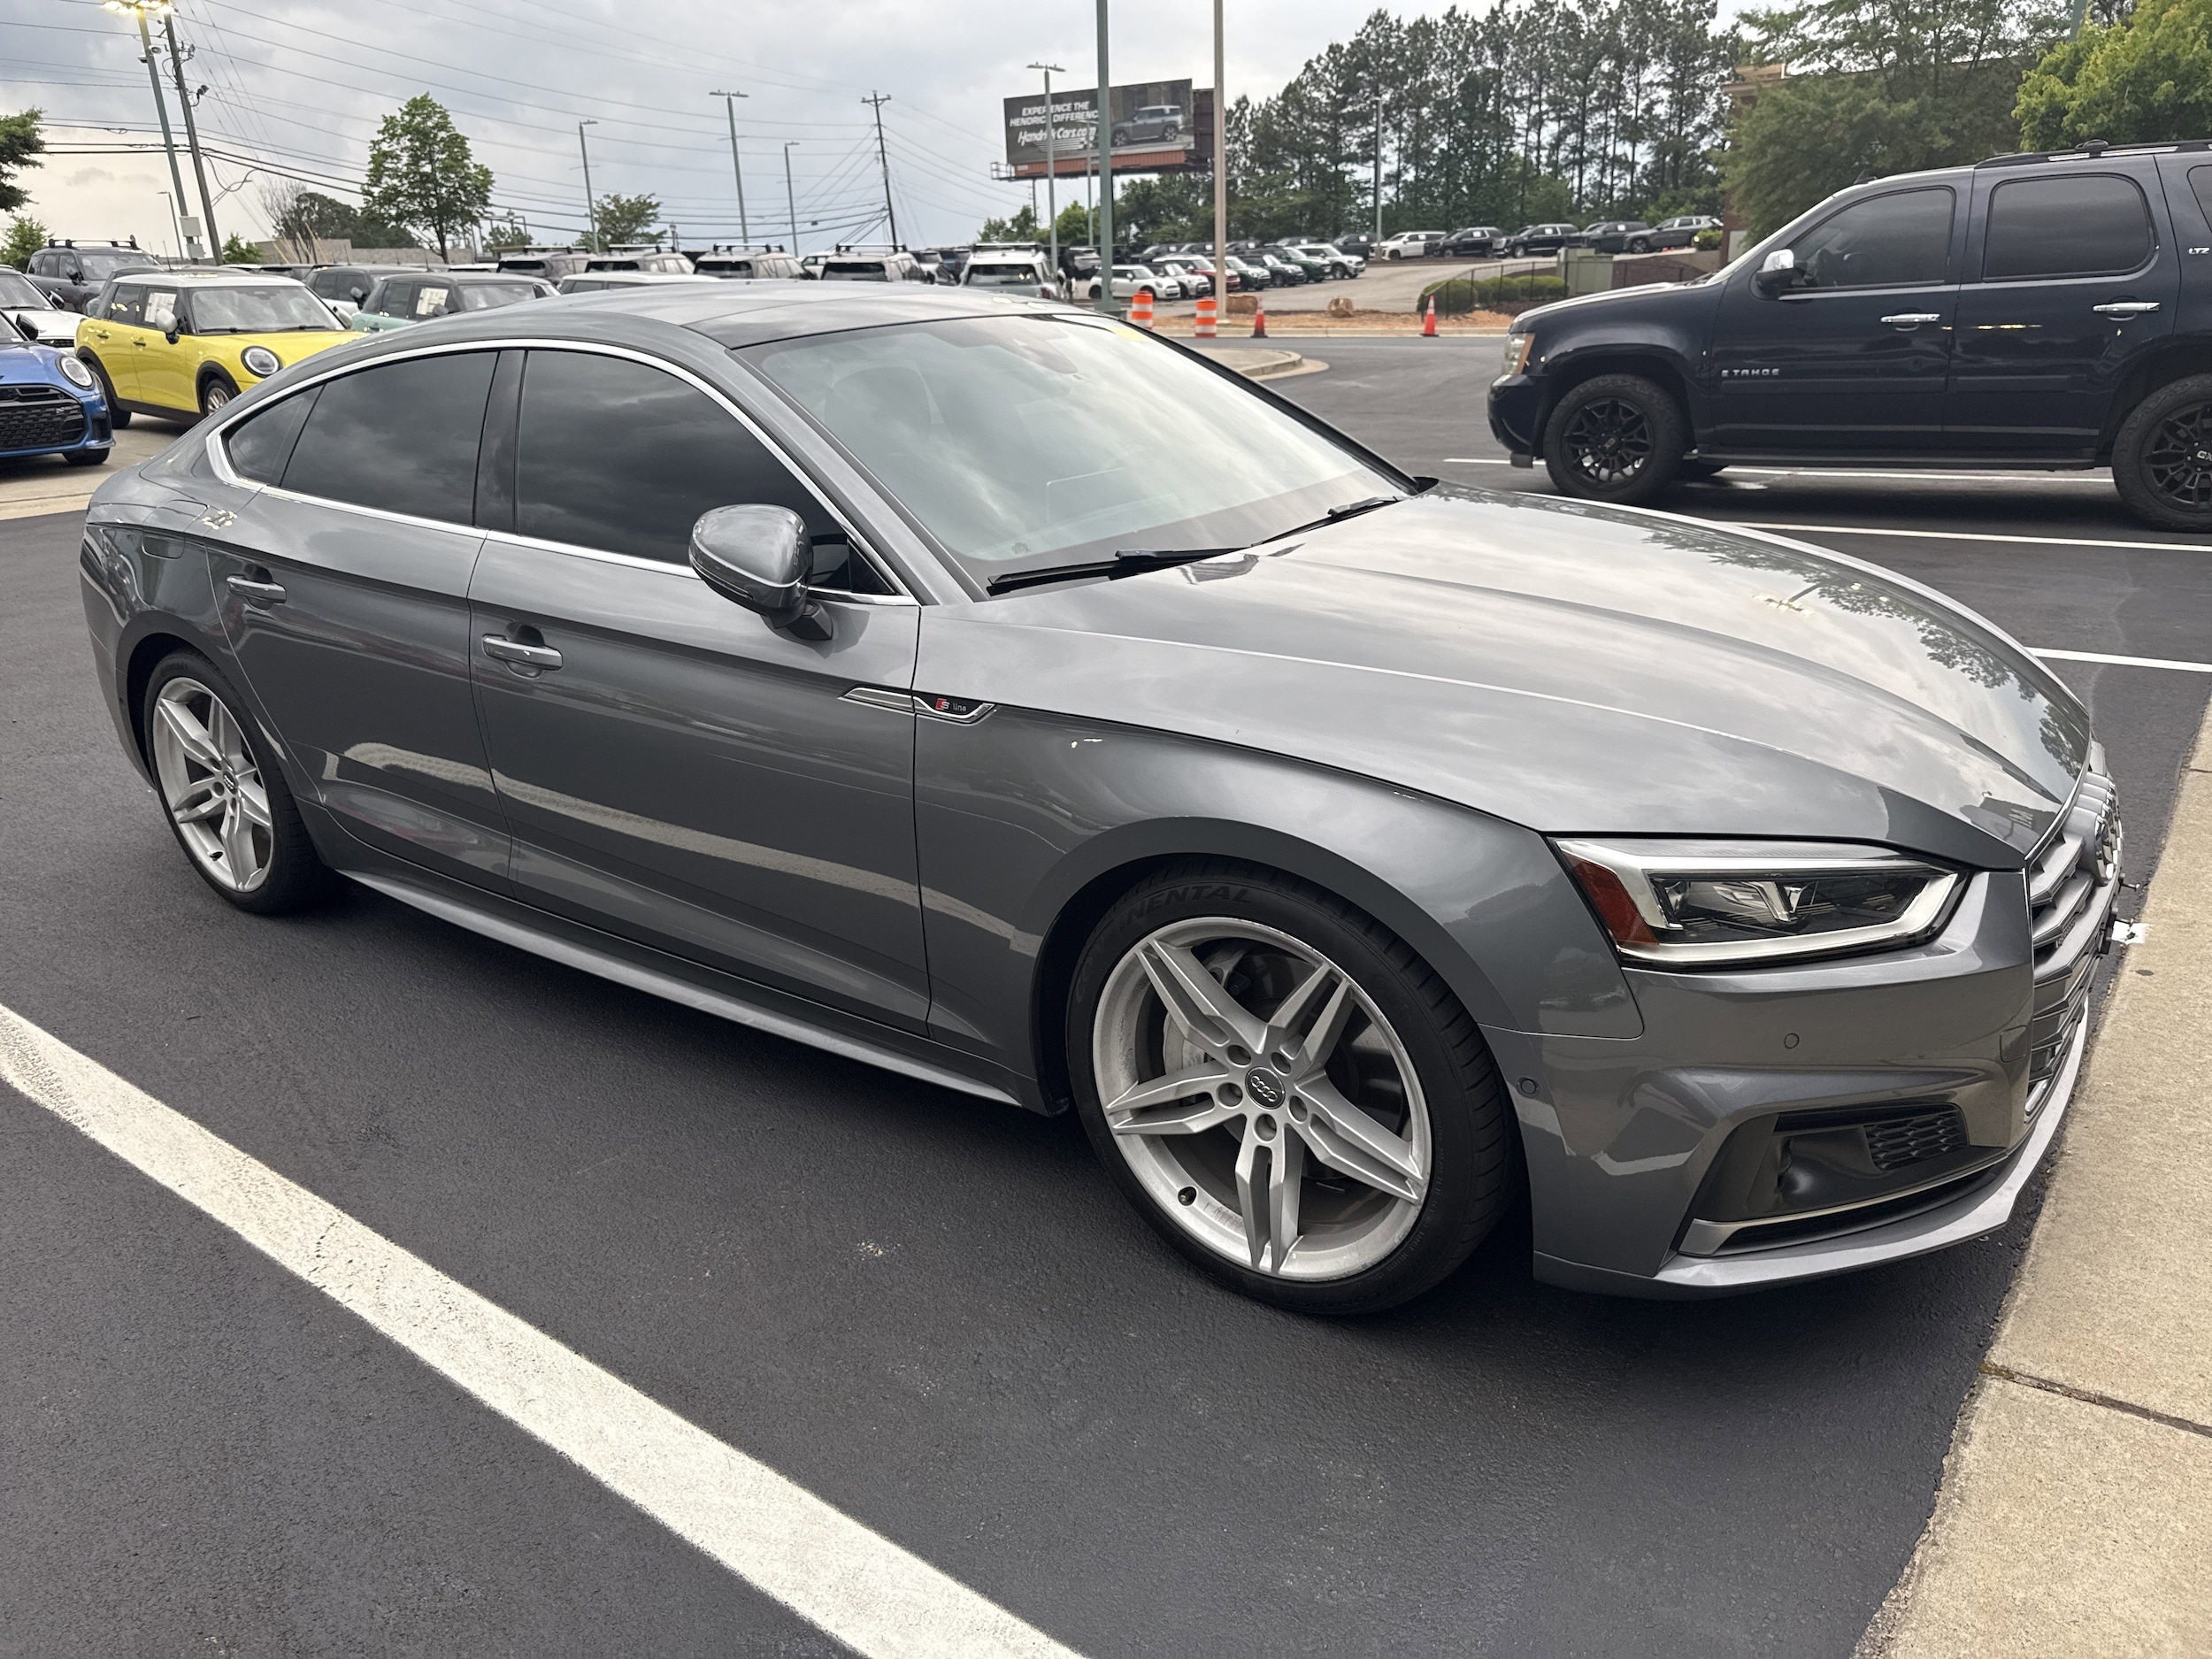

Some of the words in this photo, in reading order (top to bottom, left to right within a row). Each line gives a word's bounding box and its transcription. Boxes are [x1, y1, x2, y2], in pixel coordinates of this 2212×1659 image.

[1022, 103, 1071, 116] EXPEENCE
[1073, 101, 1090, 111] THE
[1010, 116, 1048, 127] HENDRIC
[1053, 110, 1099, 122] DIFFERENC
